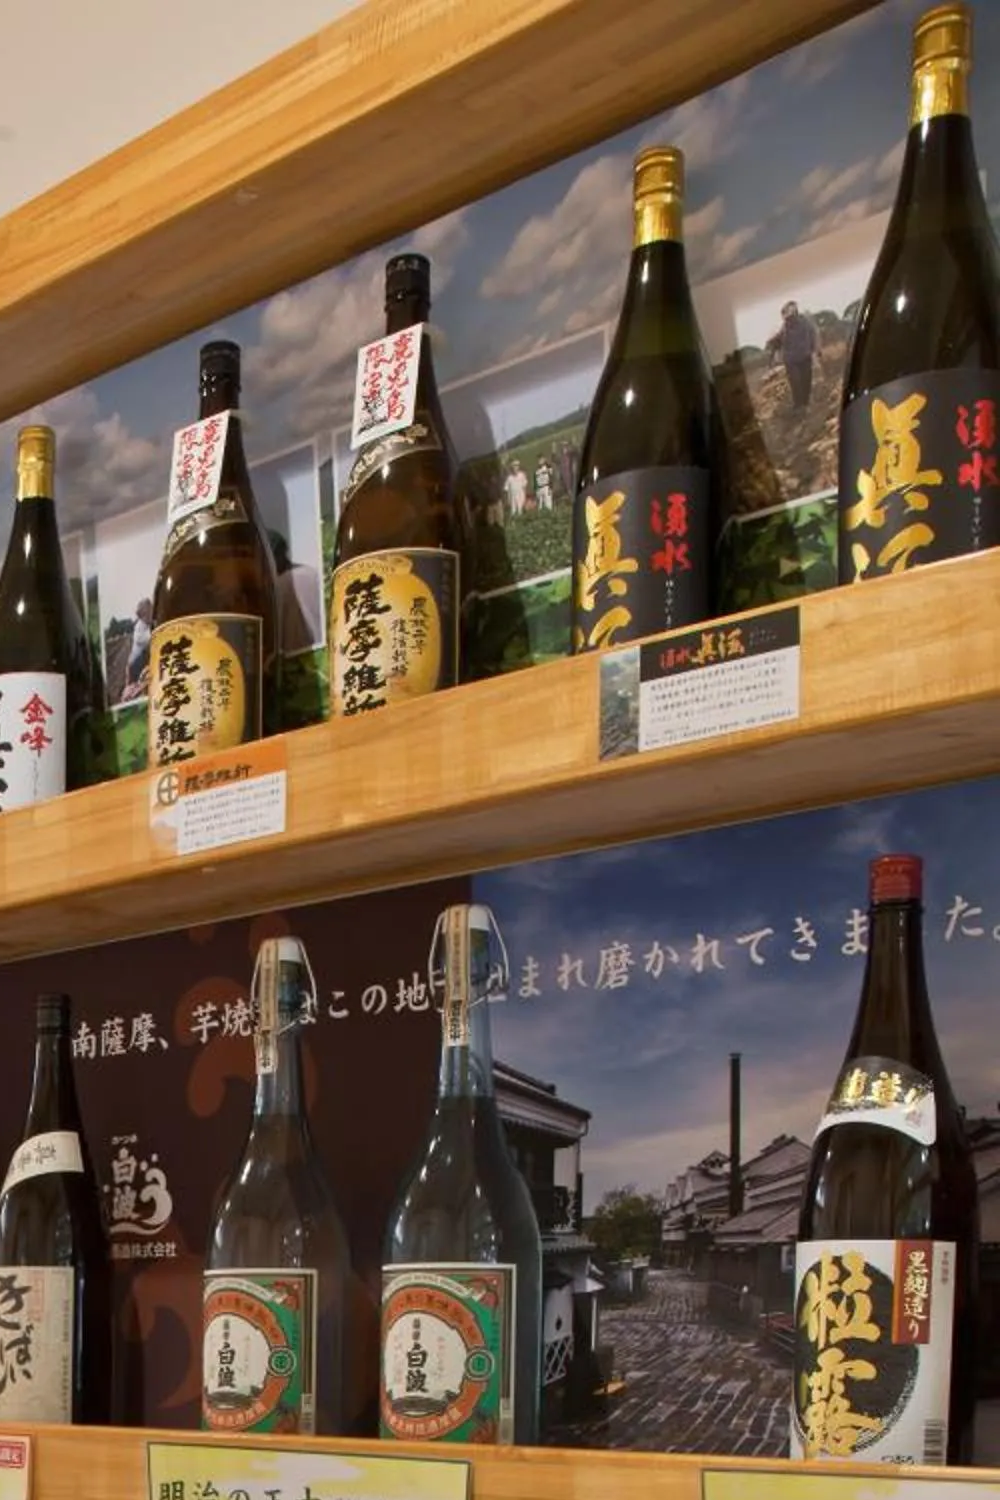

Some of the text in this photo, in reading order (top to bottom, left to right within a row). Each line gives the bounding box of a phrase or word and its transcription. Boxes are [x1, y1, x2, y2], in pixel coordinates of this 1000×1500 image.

[20, 693, 54, 757] 金峰
[406, 1341, 429, 1394] 白波
[801, 1249, 884, 1458] 粒露
